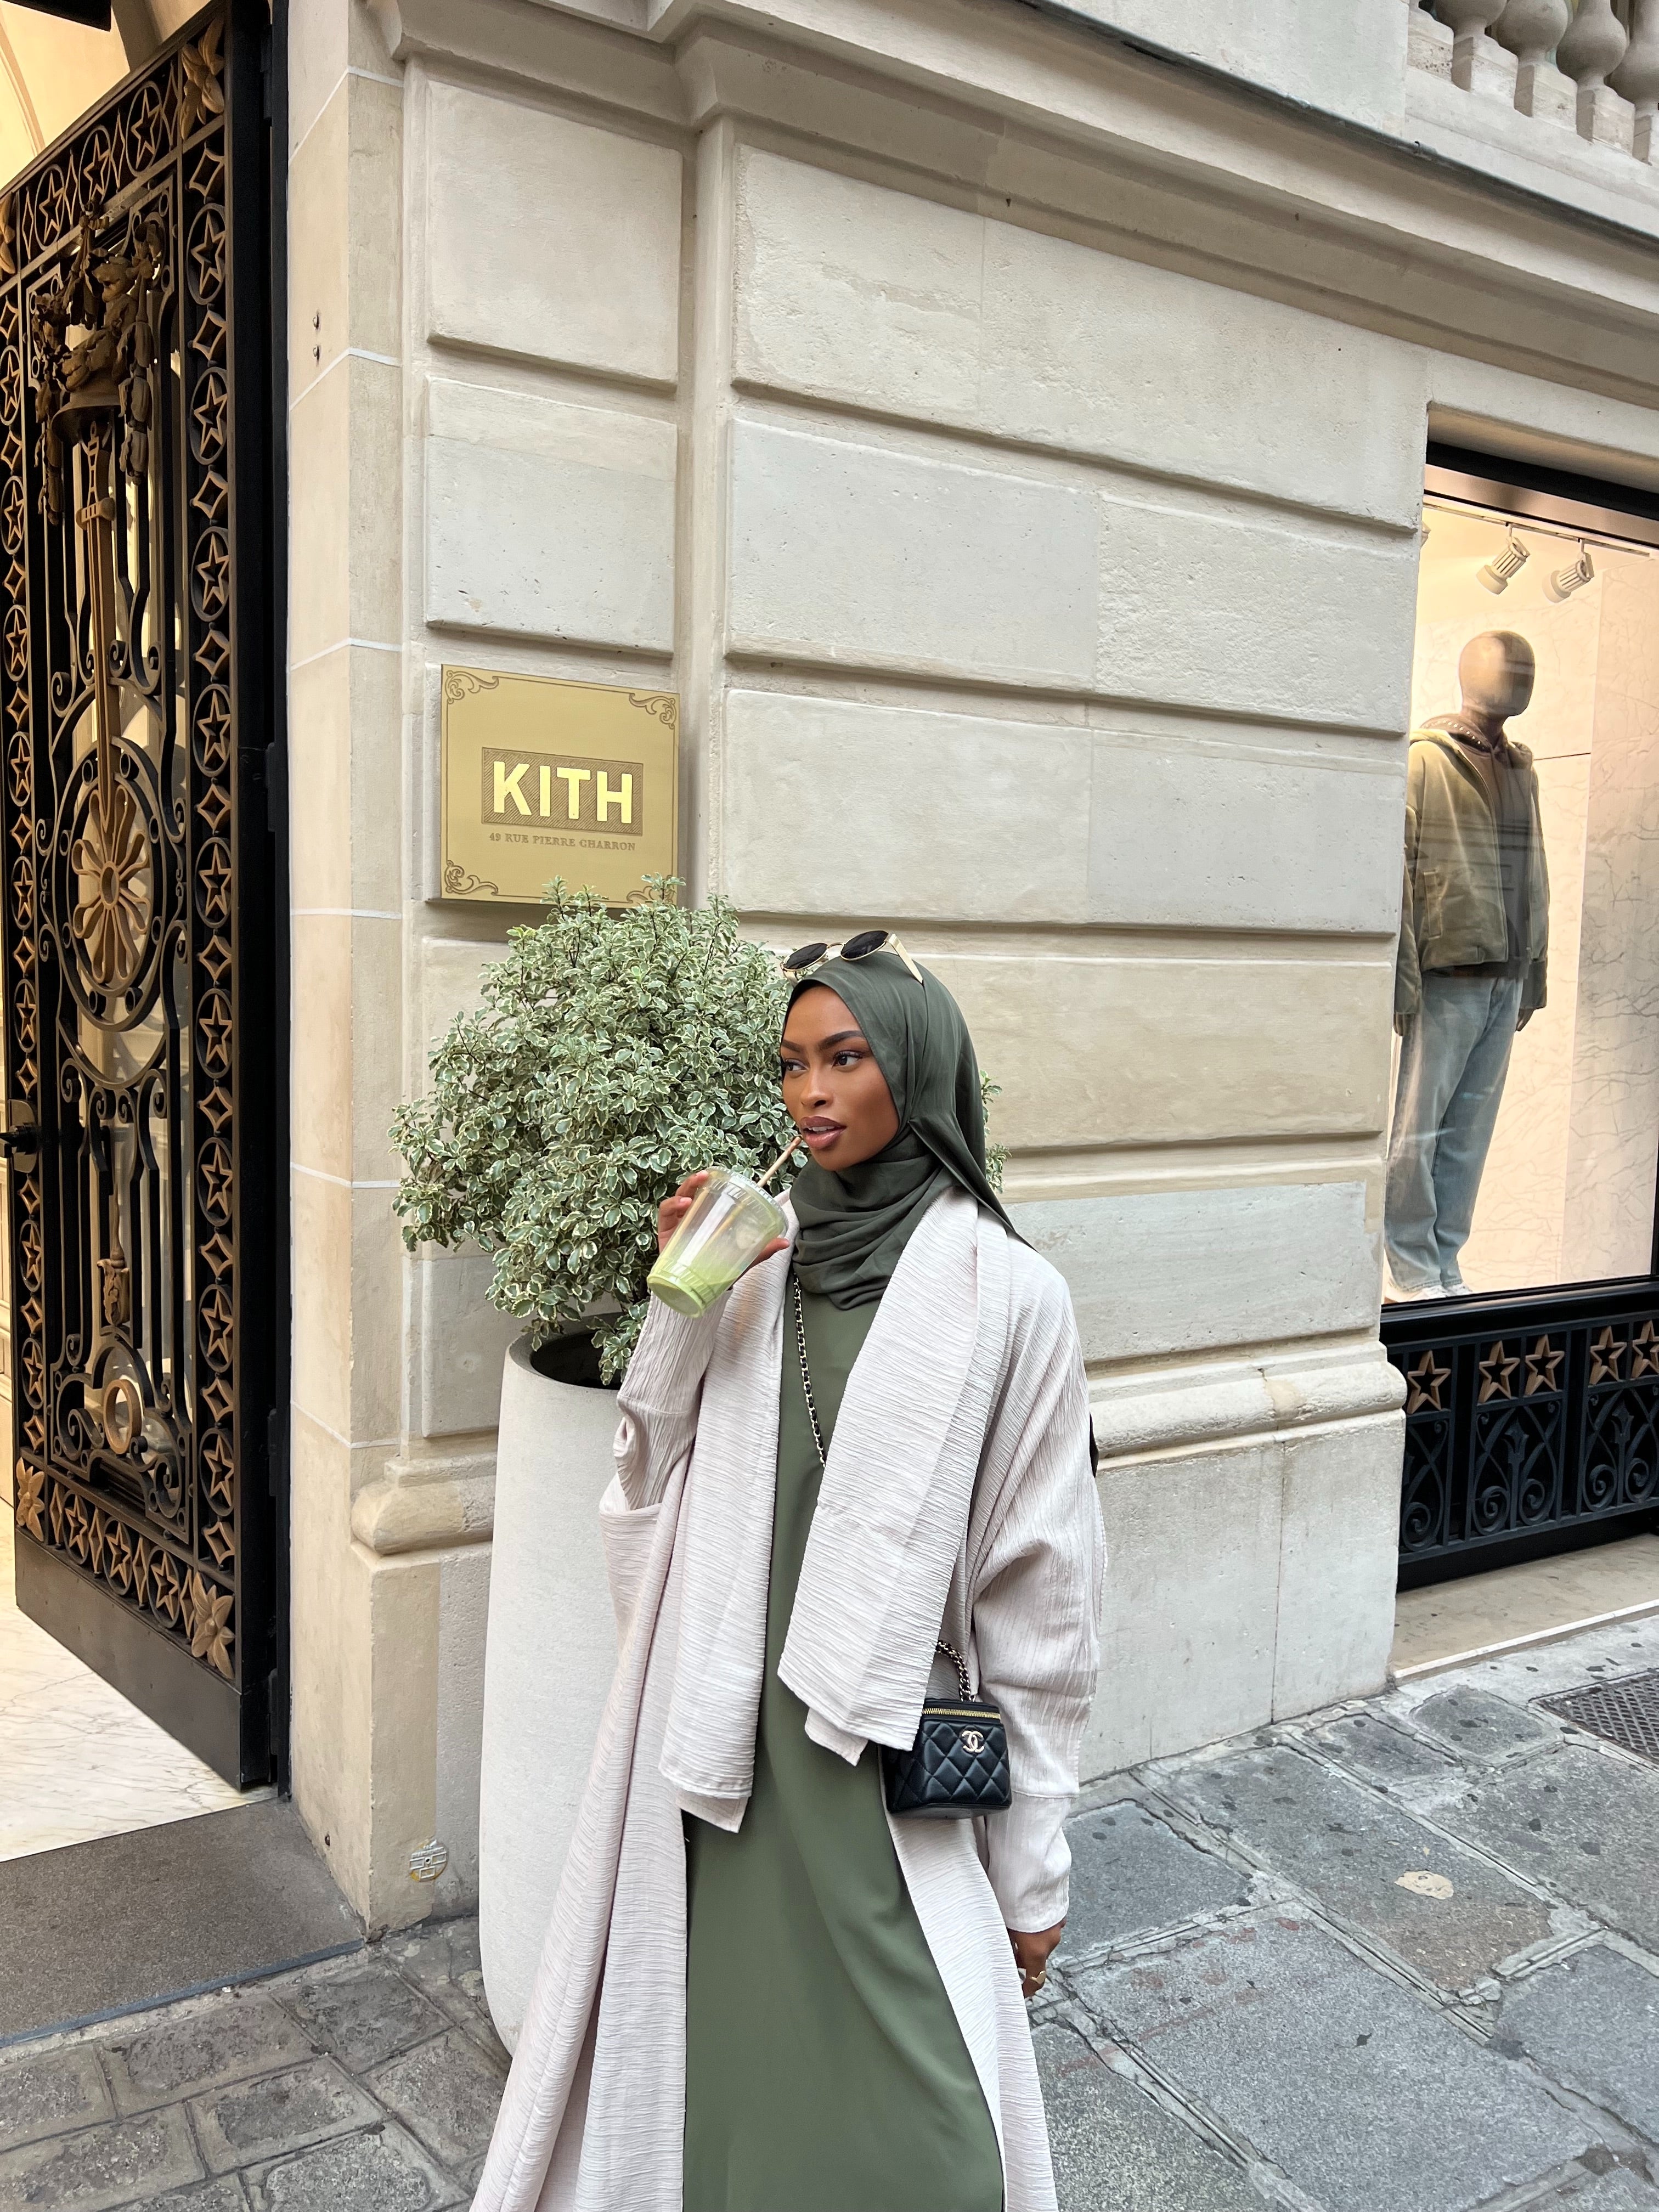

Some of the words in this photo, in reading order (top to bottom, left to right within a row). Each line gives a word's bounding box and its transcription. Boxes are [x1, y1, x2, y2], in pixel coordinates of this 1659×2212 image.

[493, 761, 633, 824] KITH
[489, 833, 501, 841] 49
[505, 833, 529, 843] RUE
[533, 836, 575, 847] PIERRE
[579, 839, 635, 851] CHARRON
